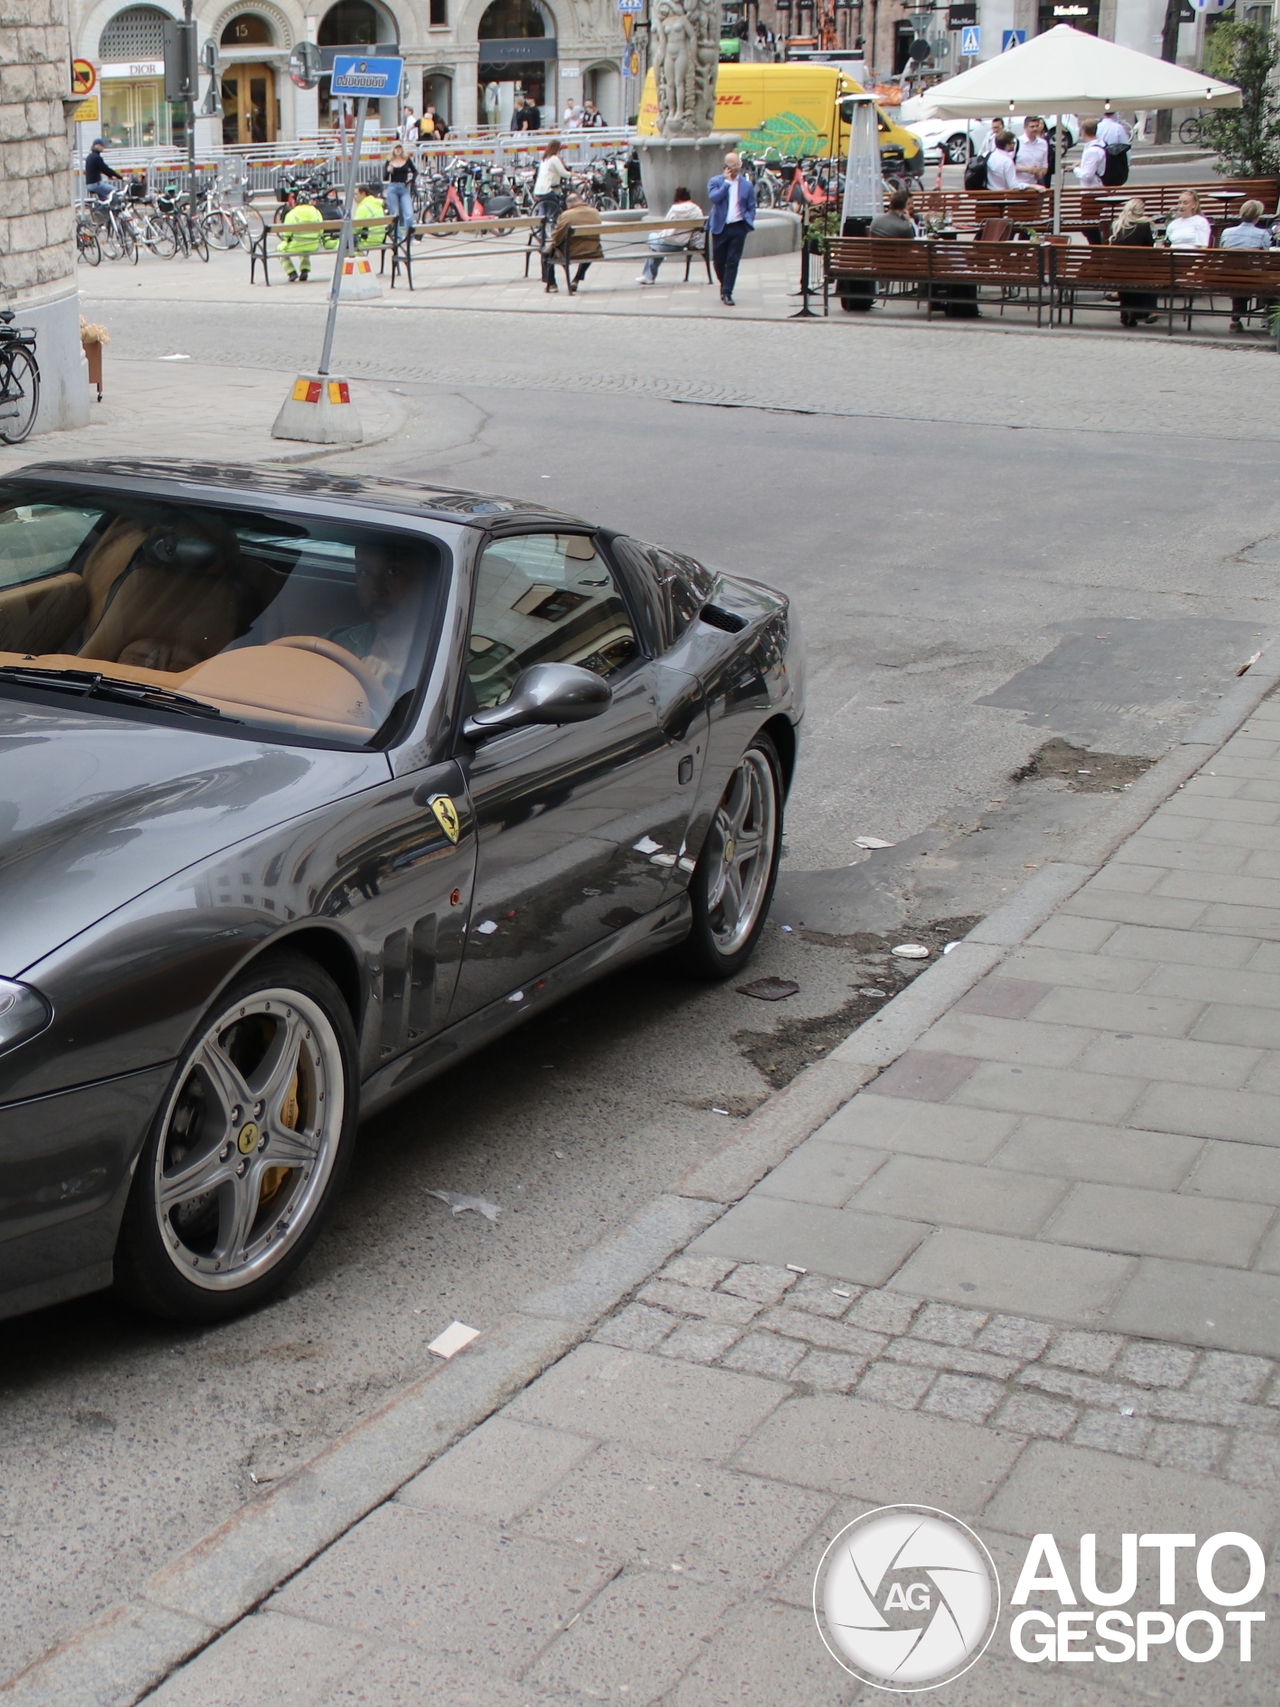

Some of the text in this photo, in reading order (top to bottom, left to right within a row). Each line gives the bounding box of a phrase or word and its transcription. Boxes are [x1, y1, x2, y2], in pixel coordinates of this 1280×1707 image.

[236, 24, 248, 36] 15
[129, 64, 157, 75] DIOR
[713, 95, 744, 106] HL
